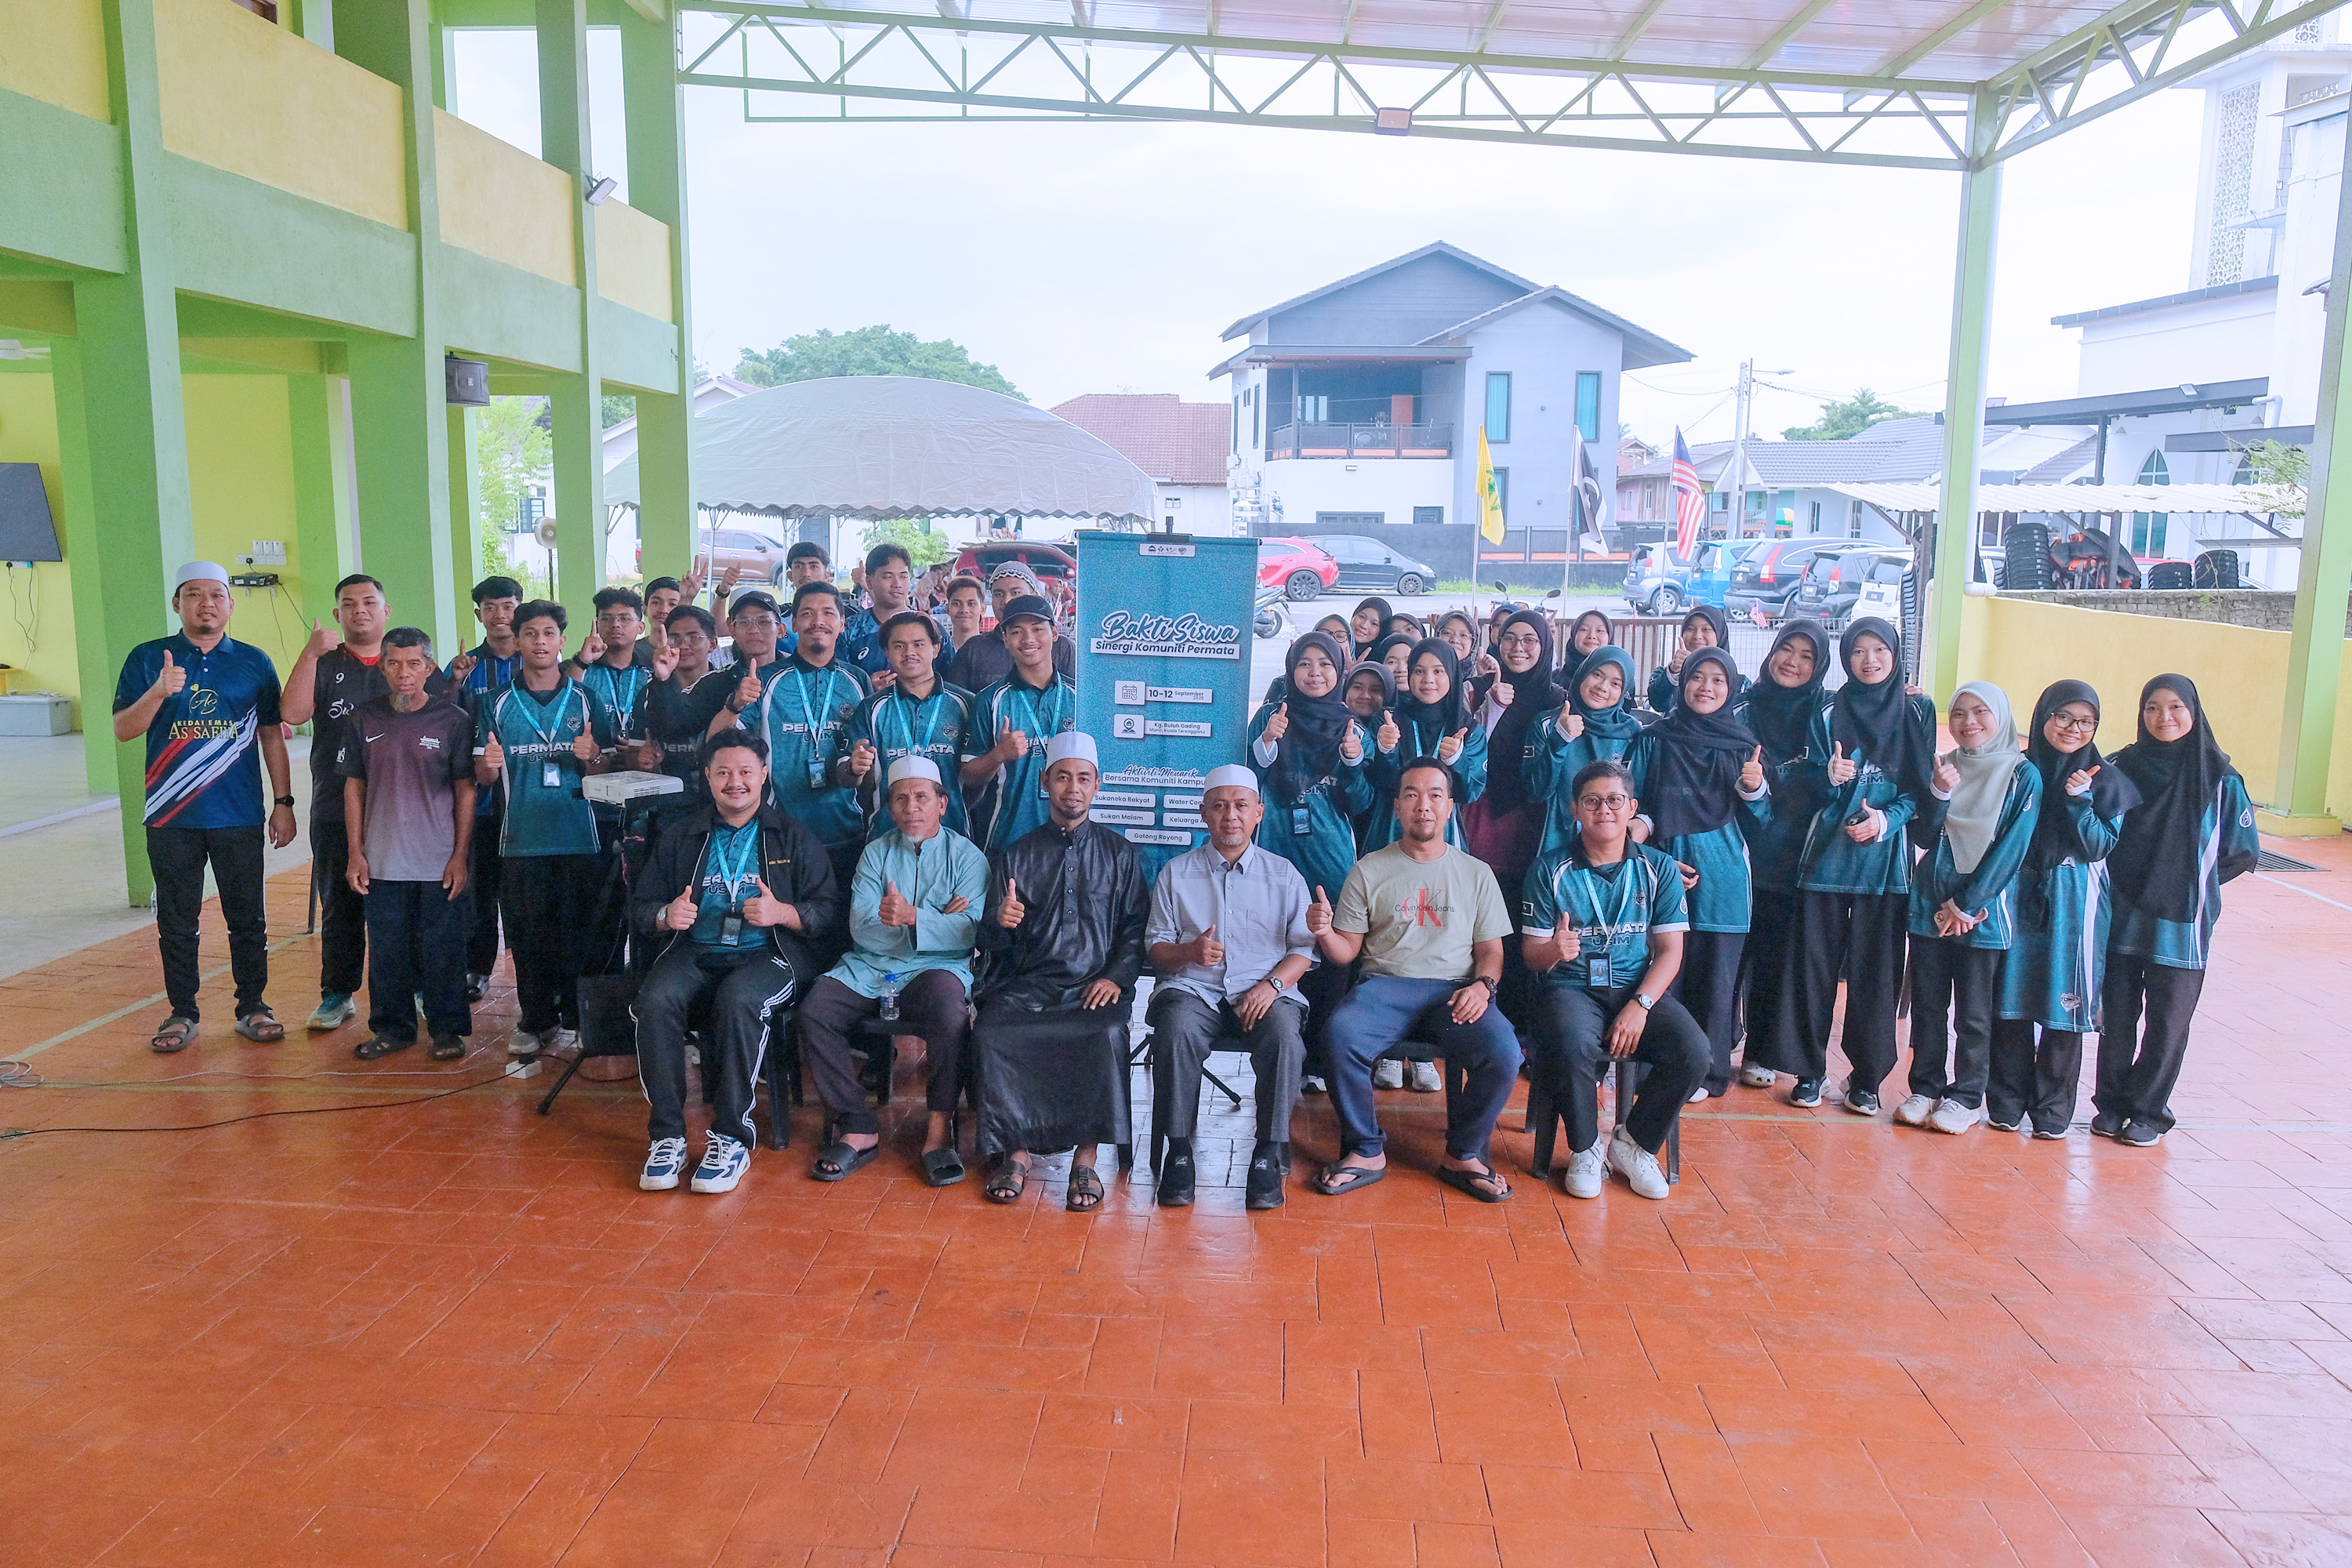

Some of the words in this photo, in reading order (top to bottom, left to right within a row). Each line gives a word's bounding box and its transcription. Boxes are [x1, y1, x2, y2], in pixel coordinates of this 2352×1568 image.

[1102, 610, 1173, 641] Bakti
[1172, 612, 1240, 644] Siswa
[1095, 641, 1134, 654] Sinergi
[1136, 643, 1185, 654] Komuniti
[1187, 644, 1235, 655] Permata
[336, 672, 345, 684] 9
[1149, 689, 1173, 699] 10-12
[1105, 774, 1140, 782] Bersama
[1178, 778, 1206, 787] Kampu
[1169, 816, 1199, 825] Keluarga
[1134, 833, 1158, 841] Gotong
[1158, 834, 1183, 843] Royong
[1433, 904, 1455, 913] Jeans
